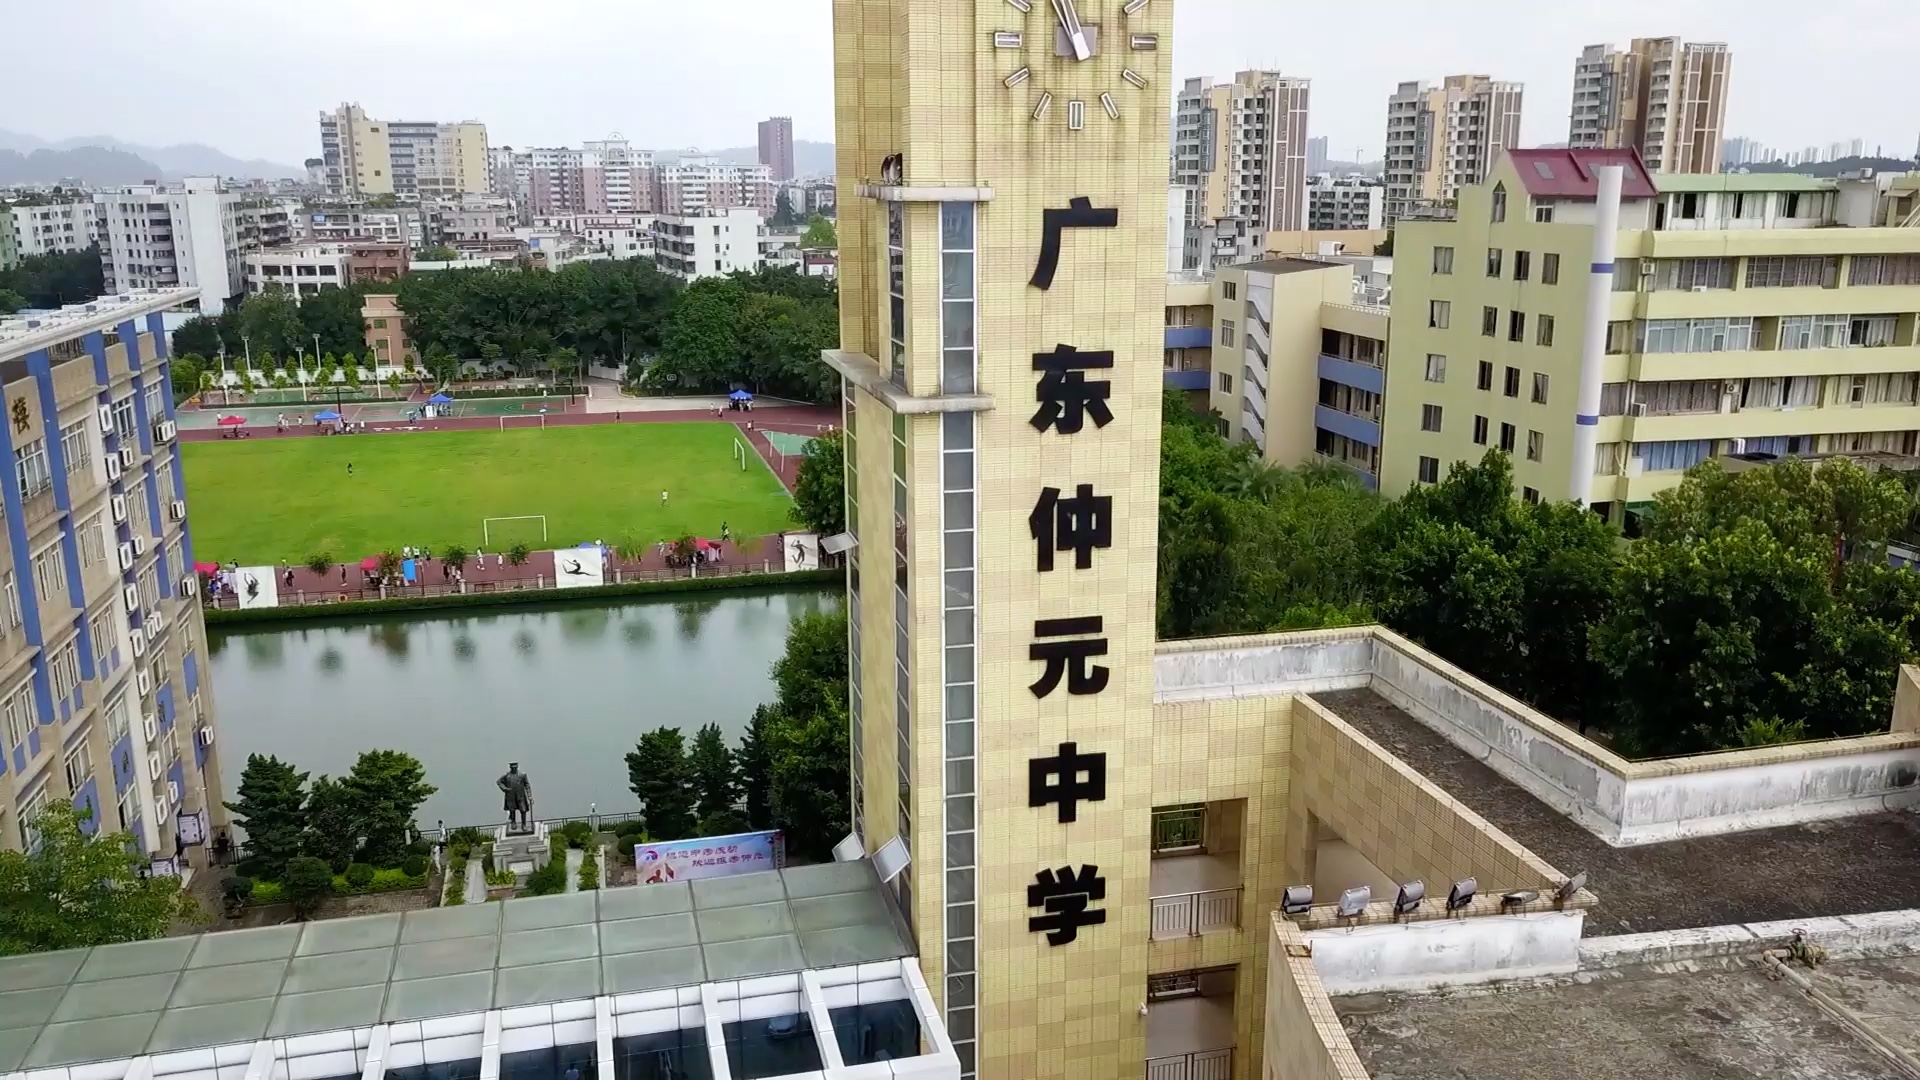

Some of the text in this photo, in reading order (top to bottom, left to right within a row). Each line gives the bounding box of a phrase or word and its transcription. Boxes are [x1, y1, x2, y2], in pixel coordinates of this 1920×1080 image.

[1028, 195, 1118, 946] 广东仲元中学
